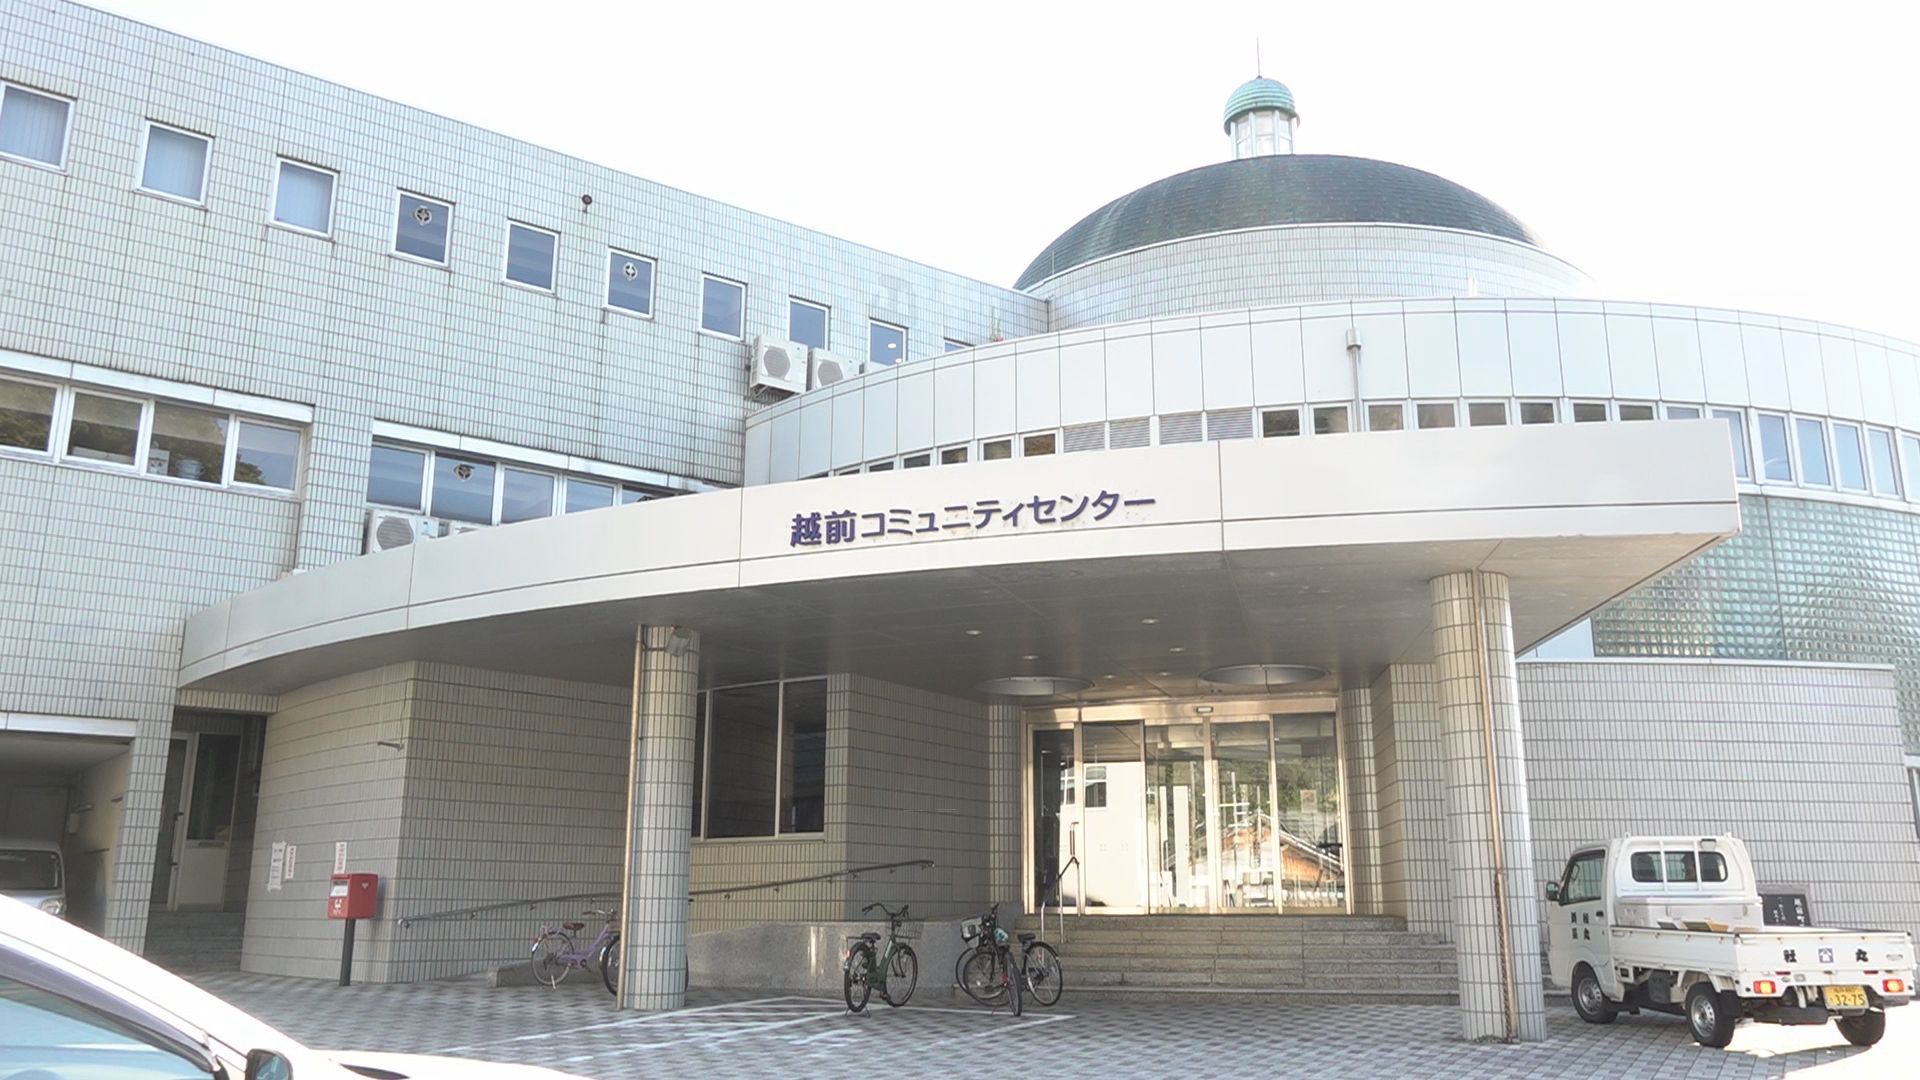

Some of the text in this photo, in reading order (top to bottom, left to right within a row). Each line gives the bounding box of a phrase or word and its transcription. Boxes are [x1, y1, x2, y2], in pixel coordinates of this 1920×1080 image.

[790, 490, 1156, 547] 越前コミュニティセンター
